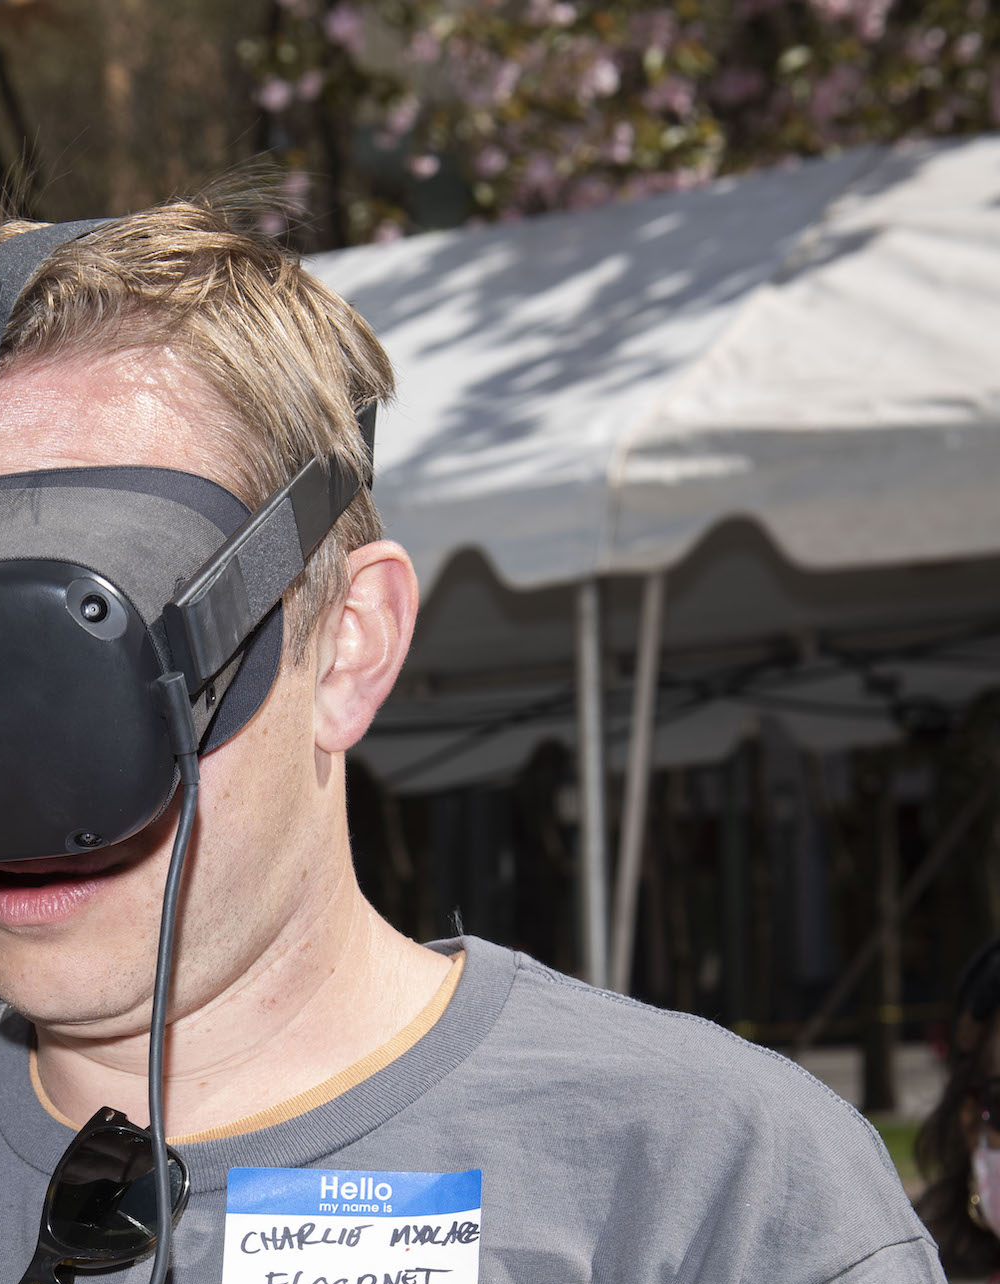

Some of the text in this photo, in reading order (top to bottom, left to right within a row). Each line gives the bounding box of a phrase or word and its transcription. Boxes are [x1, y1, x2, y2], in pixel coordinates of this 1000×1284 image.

[320, 1176, 393, 1201] Hello
[319, 1202, 393, 1214] my name is
[240, 1222, 374, 1254] CHARLIE
